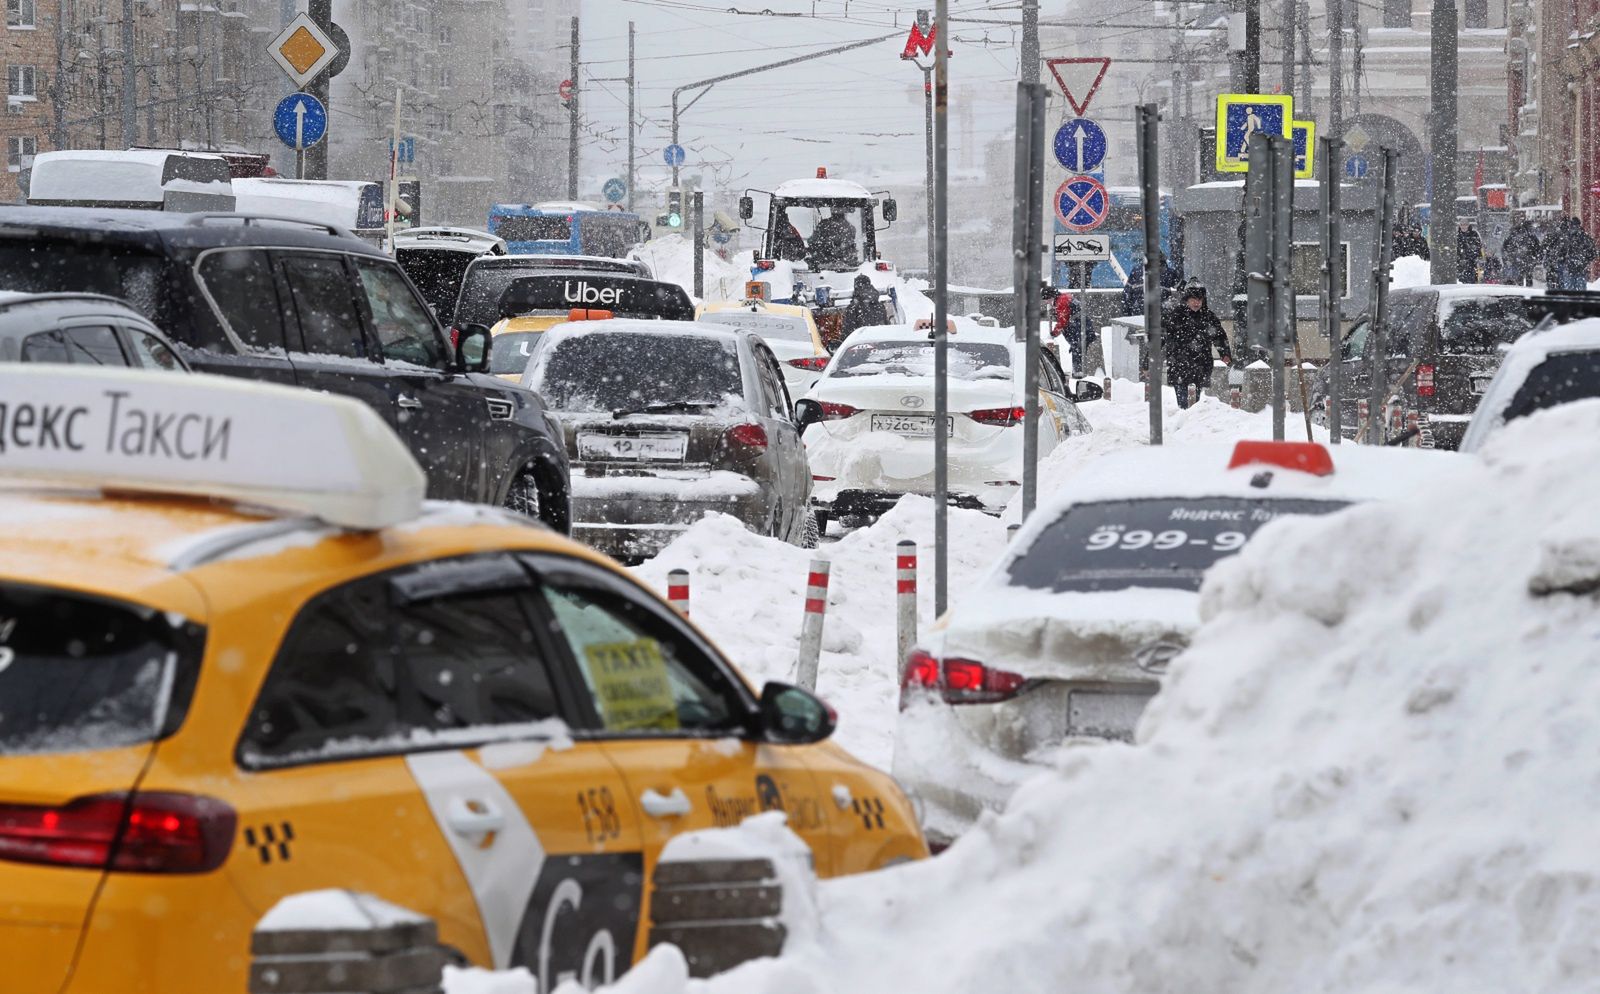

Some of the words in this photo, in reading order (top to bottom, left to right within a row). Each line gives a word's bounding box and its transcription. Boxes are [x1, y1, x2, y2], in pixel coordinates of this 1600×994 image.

[564, 280, 625, 304] Uber
[102, 389, 233, 462] Такси
[1168, 507, 1246, 522] Яндекс
[1249, 508, 1279, 522] Та
[577, 786, 621, 843] 158
